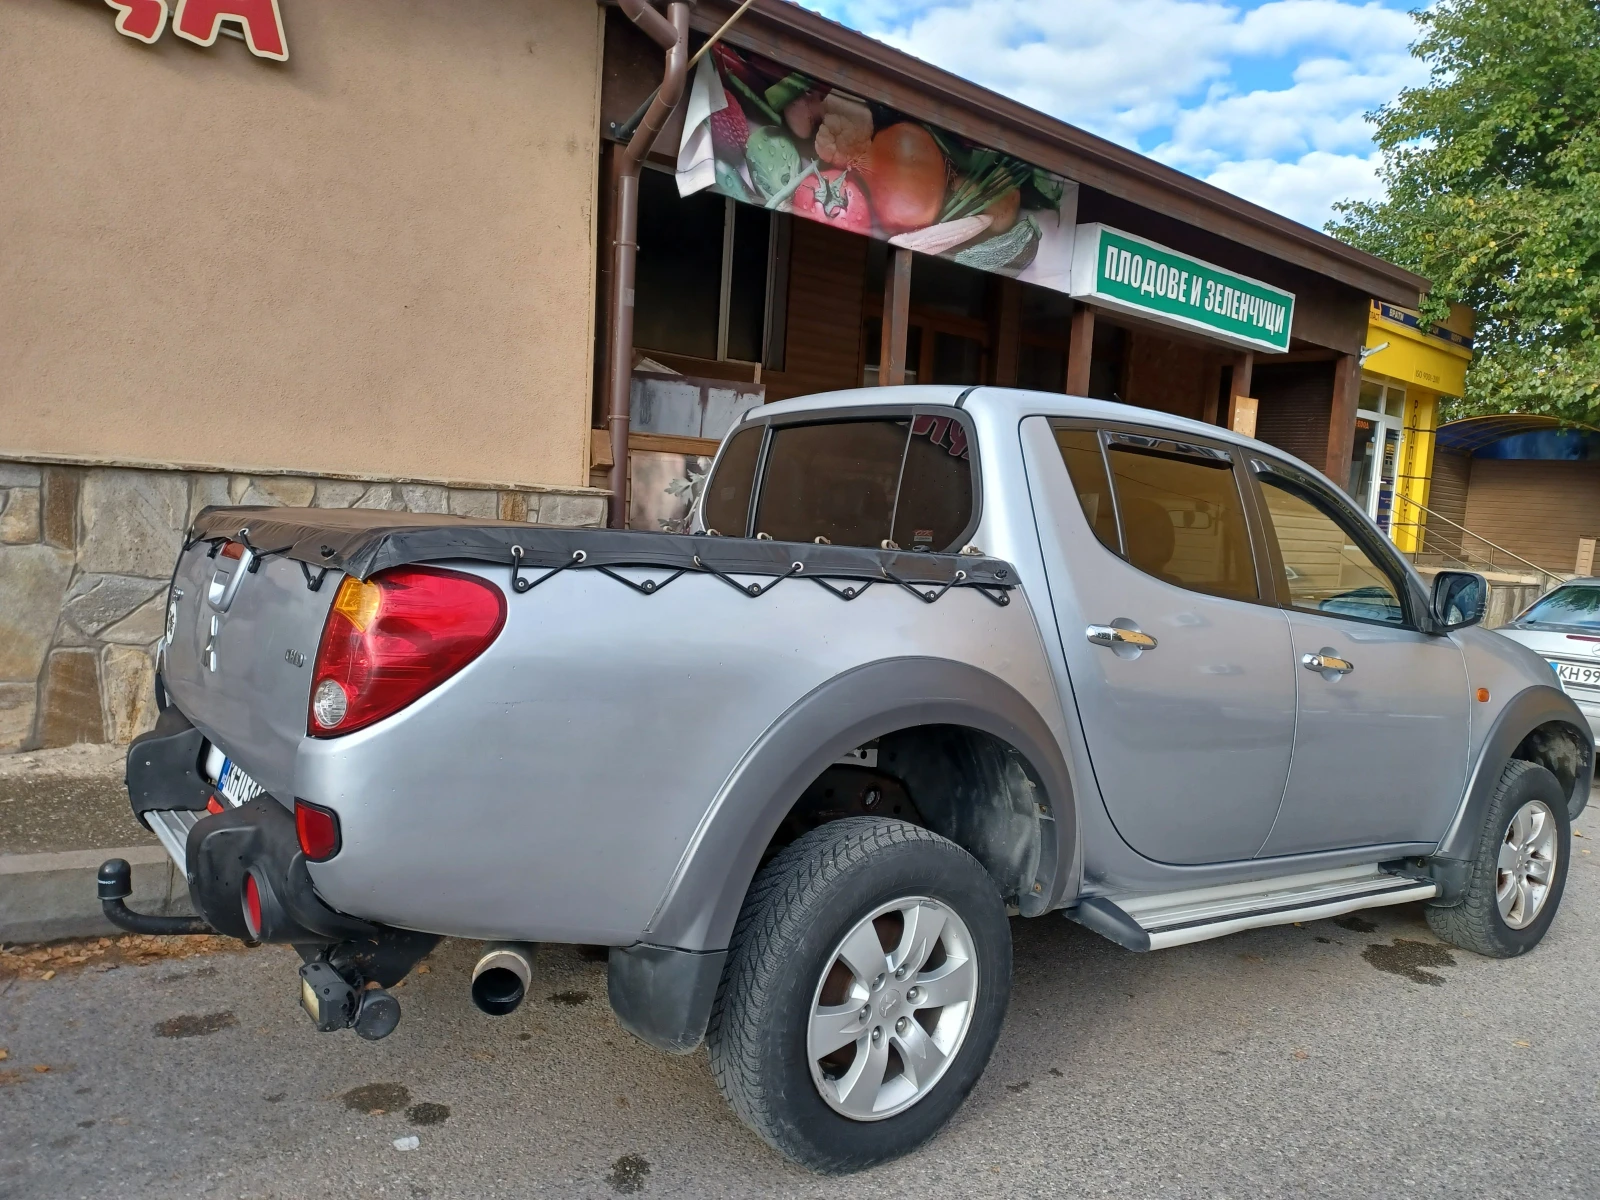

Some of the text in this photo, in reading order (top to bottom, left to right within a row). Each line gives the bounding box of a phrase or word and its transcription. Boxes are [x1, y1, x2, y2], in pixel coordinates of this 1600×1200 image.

[1104, 245, 1286, 335] ПЛОДОВЕ И ЗЕЛЕНЧУЦИ
